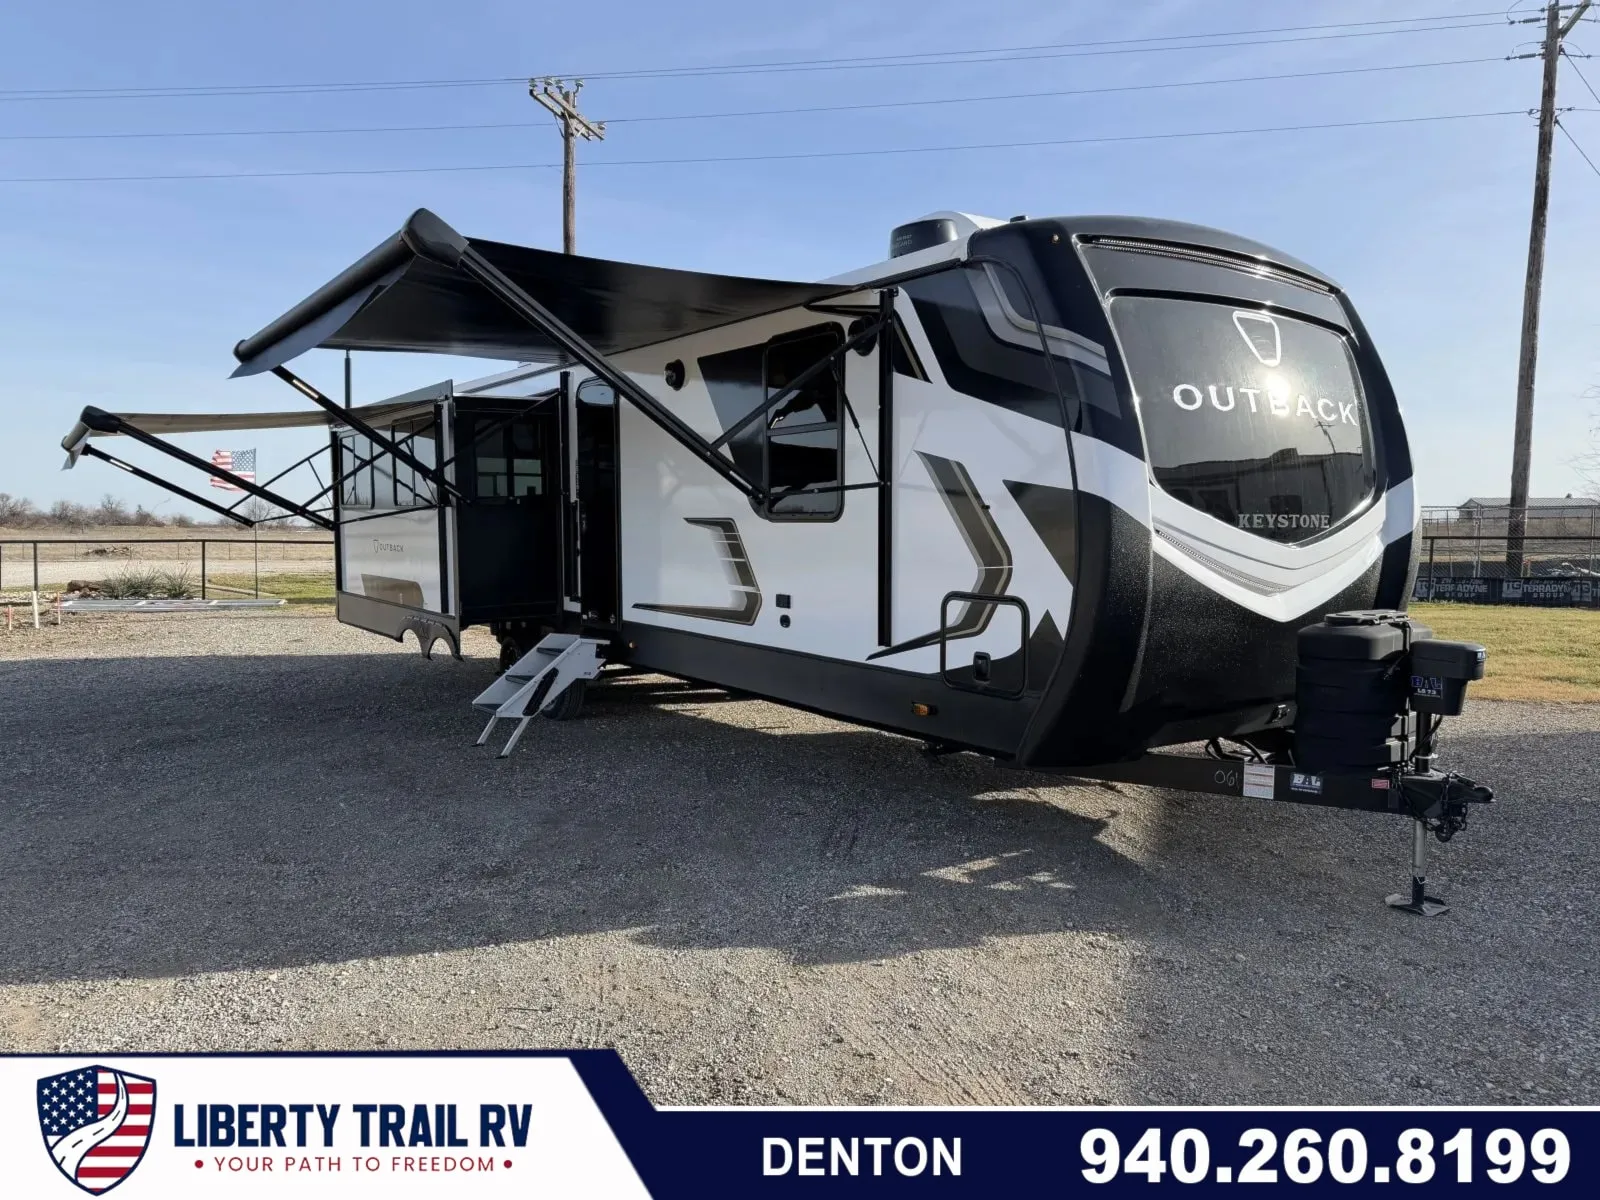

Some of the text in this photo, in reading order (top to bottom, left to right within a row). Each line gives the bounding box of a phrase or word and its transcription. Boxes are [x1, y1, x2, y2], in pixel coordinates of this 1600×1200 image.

[1173, 383, 1357, 426] OUTBACK
[1238, 514, 1331, 529] KEYSTONE
[380, 543, 404, 552] OUTBACK
[1523, 584, 1571, 593] TERRADYN
